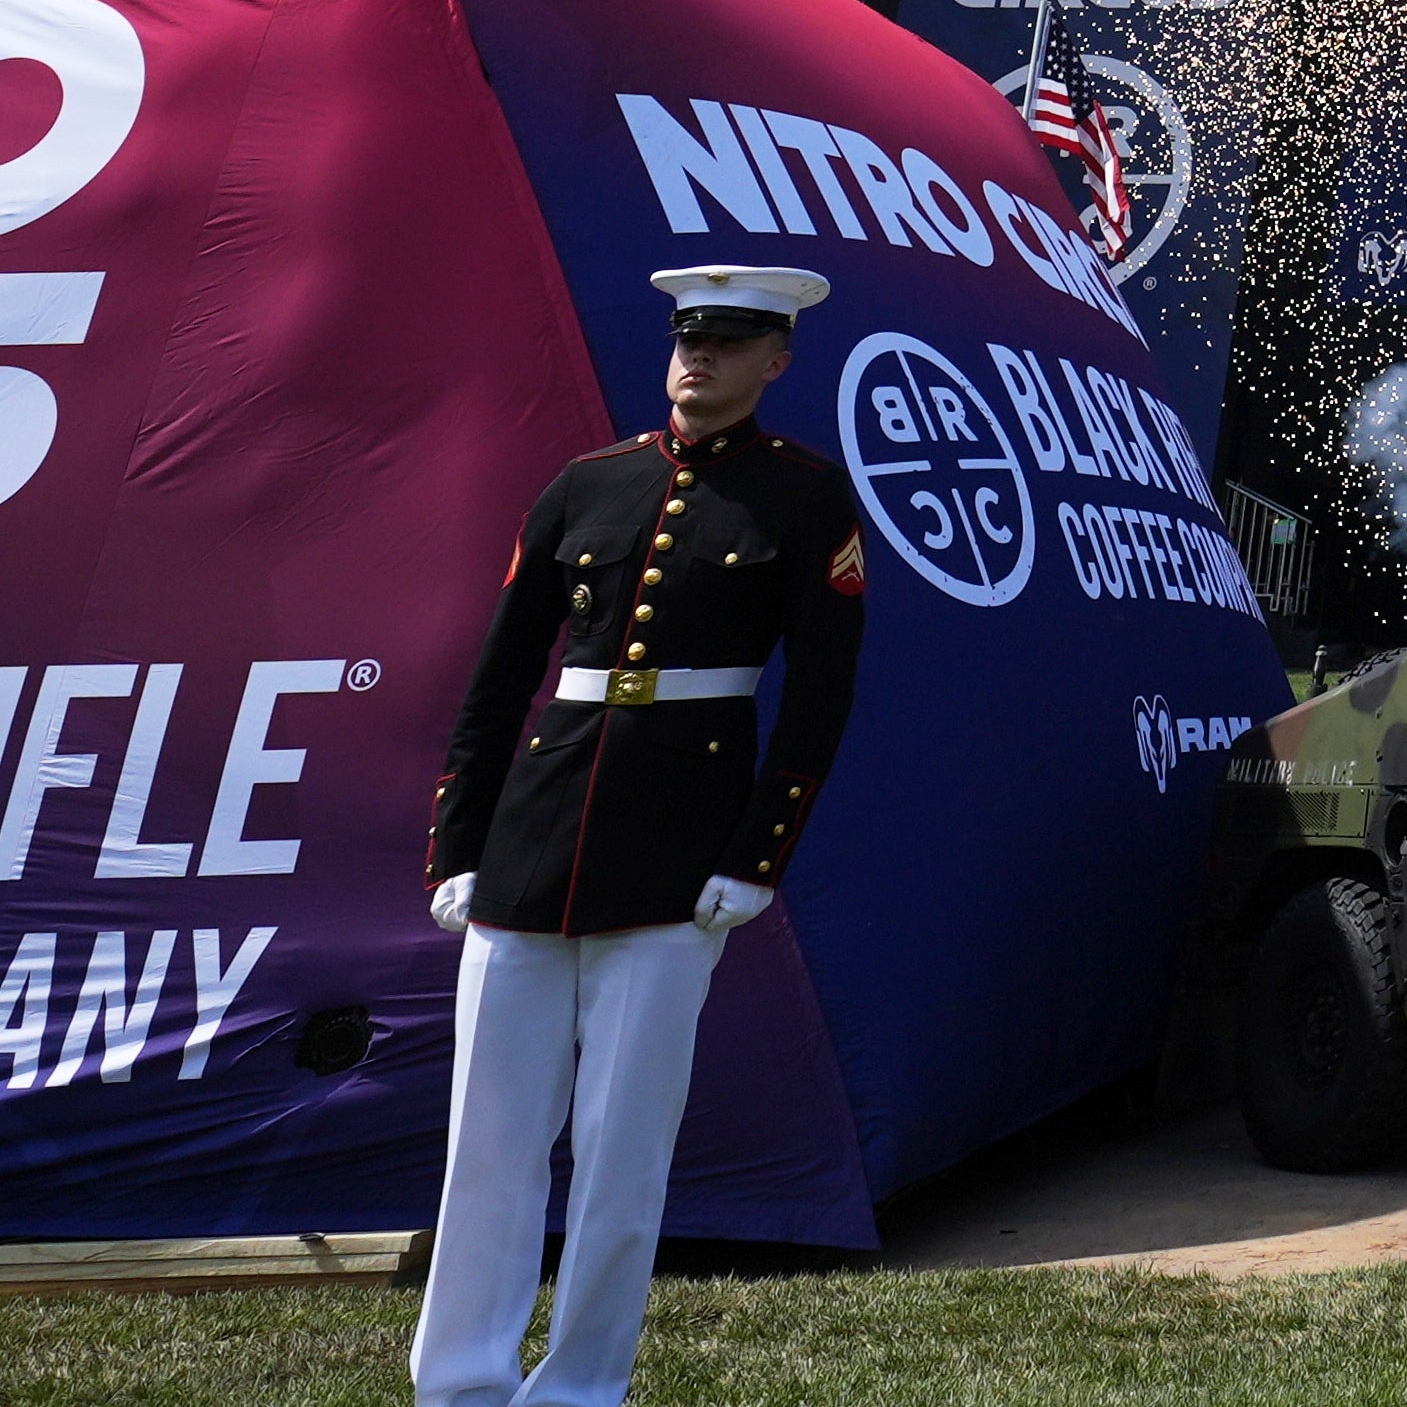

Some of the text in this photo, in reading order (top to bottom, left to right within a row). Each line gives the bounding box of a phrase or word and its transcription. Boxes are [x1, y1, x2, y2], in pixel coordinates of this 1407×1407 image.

[615, 94, 1150, 352] NITRO CIRC
[986, 343, 1178, 493] BLACK
[1058, 502, 1197, 603] COFFEE
